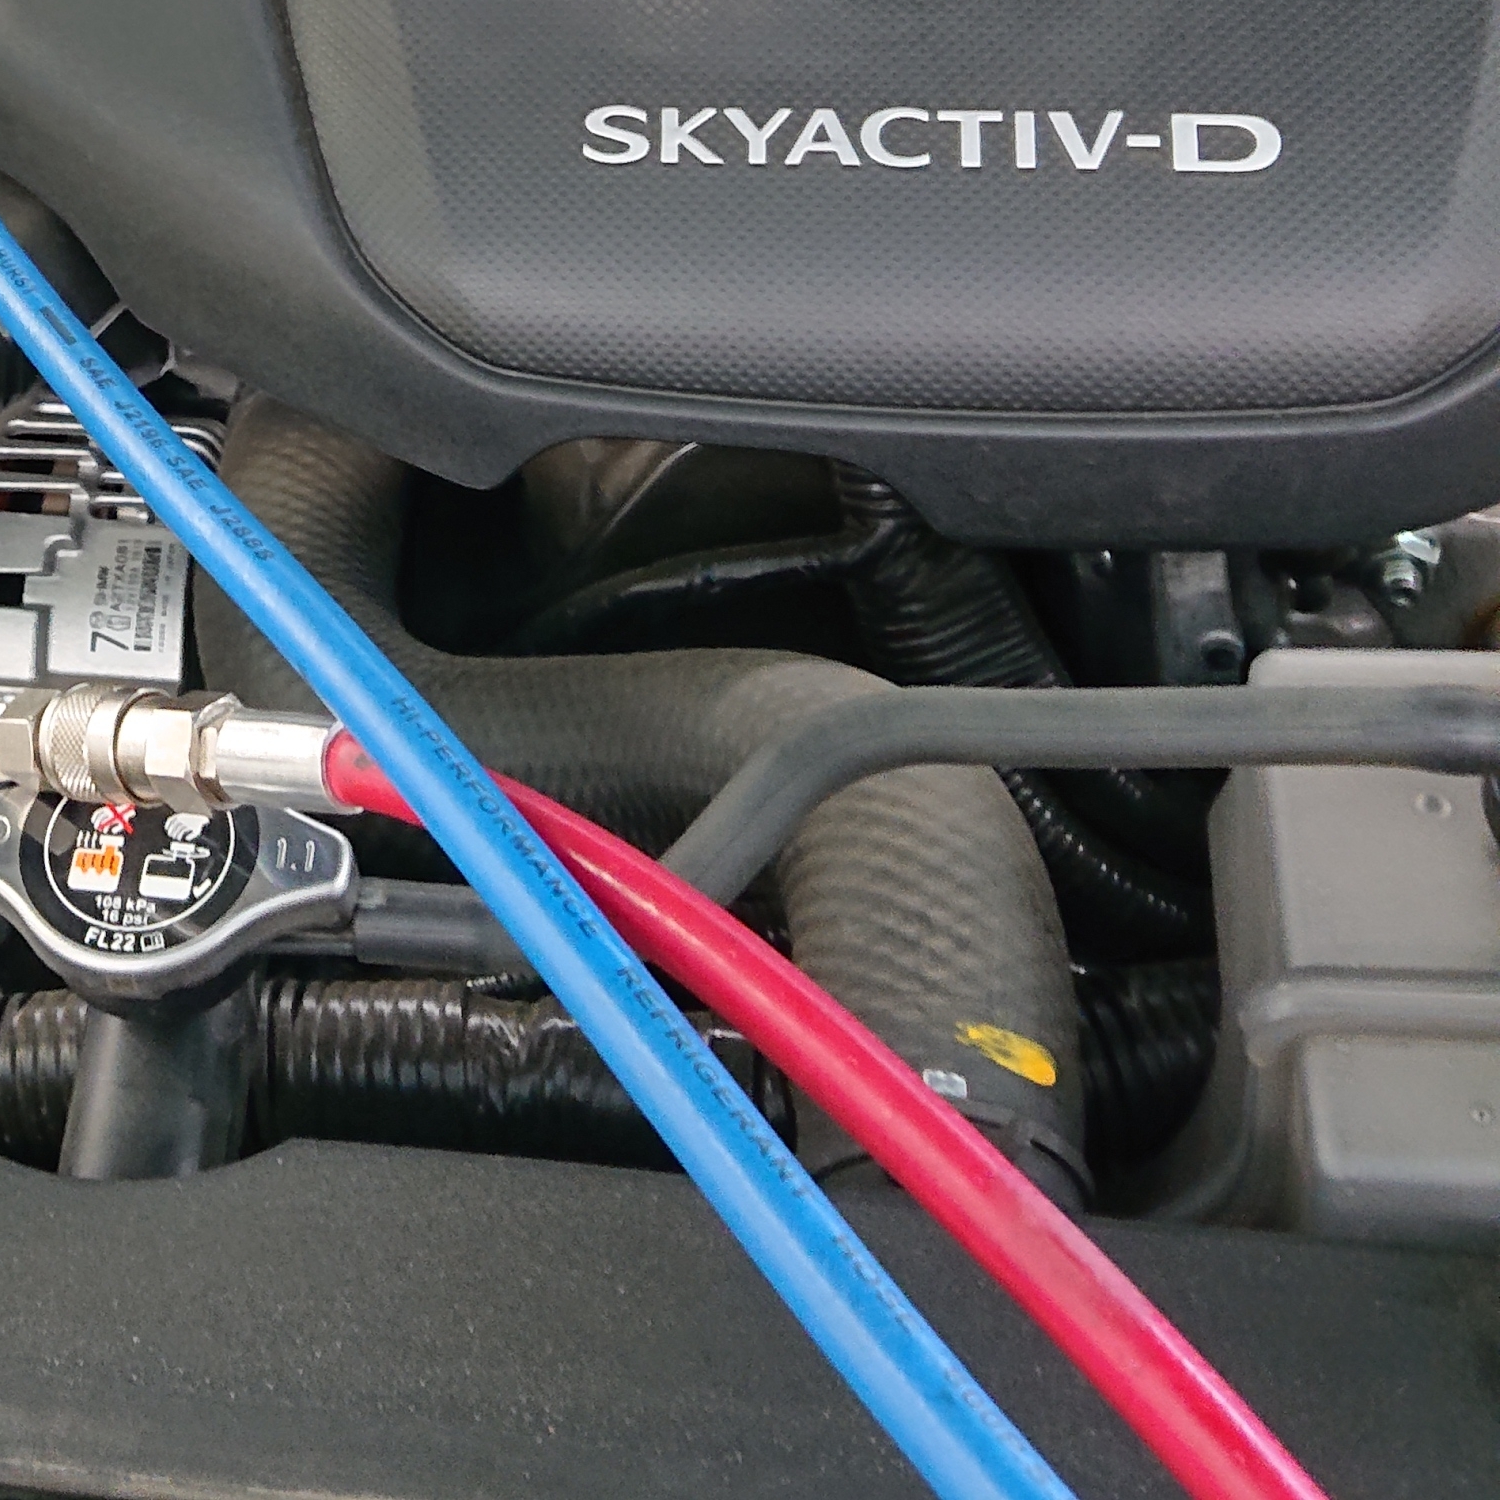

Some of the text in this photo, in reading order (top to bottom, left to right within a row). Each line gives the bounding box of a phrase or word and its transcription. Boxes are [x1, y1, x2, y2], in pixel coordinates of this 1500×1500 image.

[581, 104, 1284, 173] SKYACTIV-D
[79, 357, 118, 390] SAE
[166, 455, 210, 491] SAE
[84, 925, 136, 952] FL22
